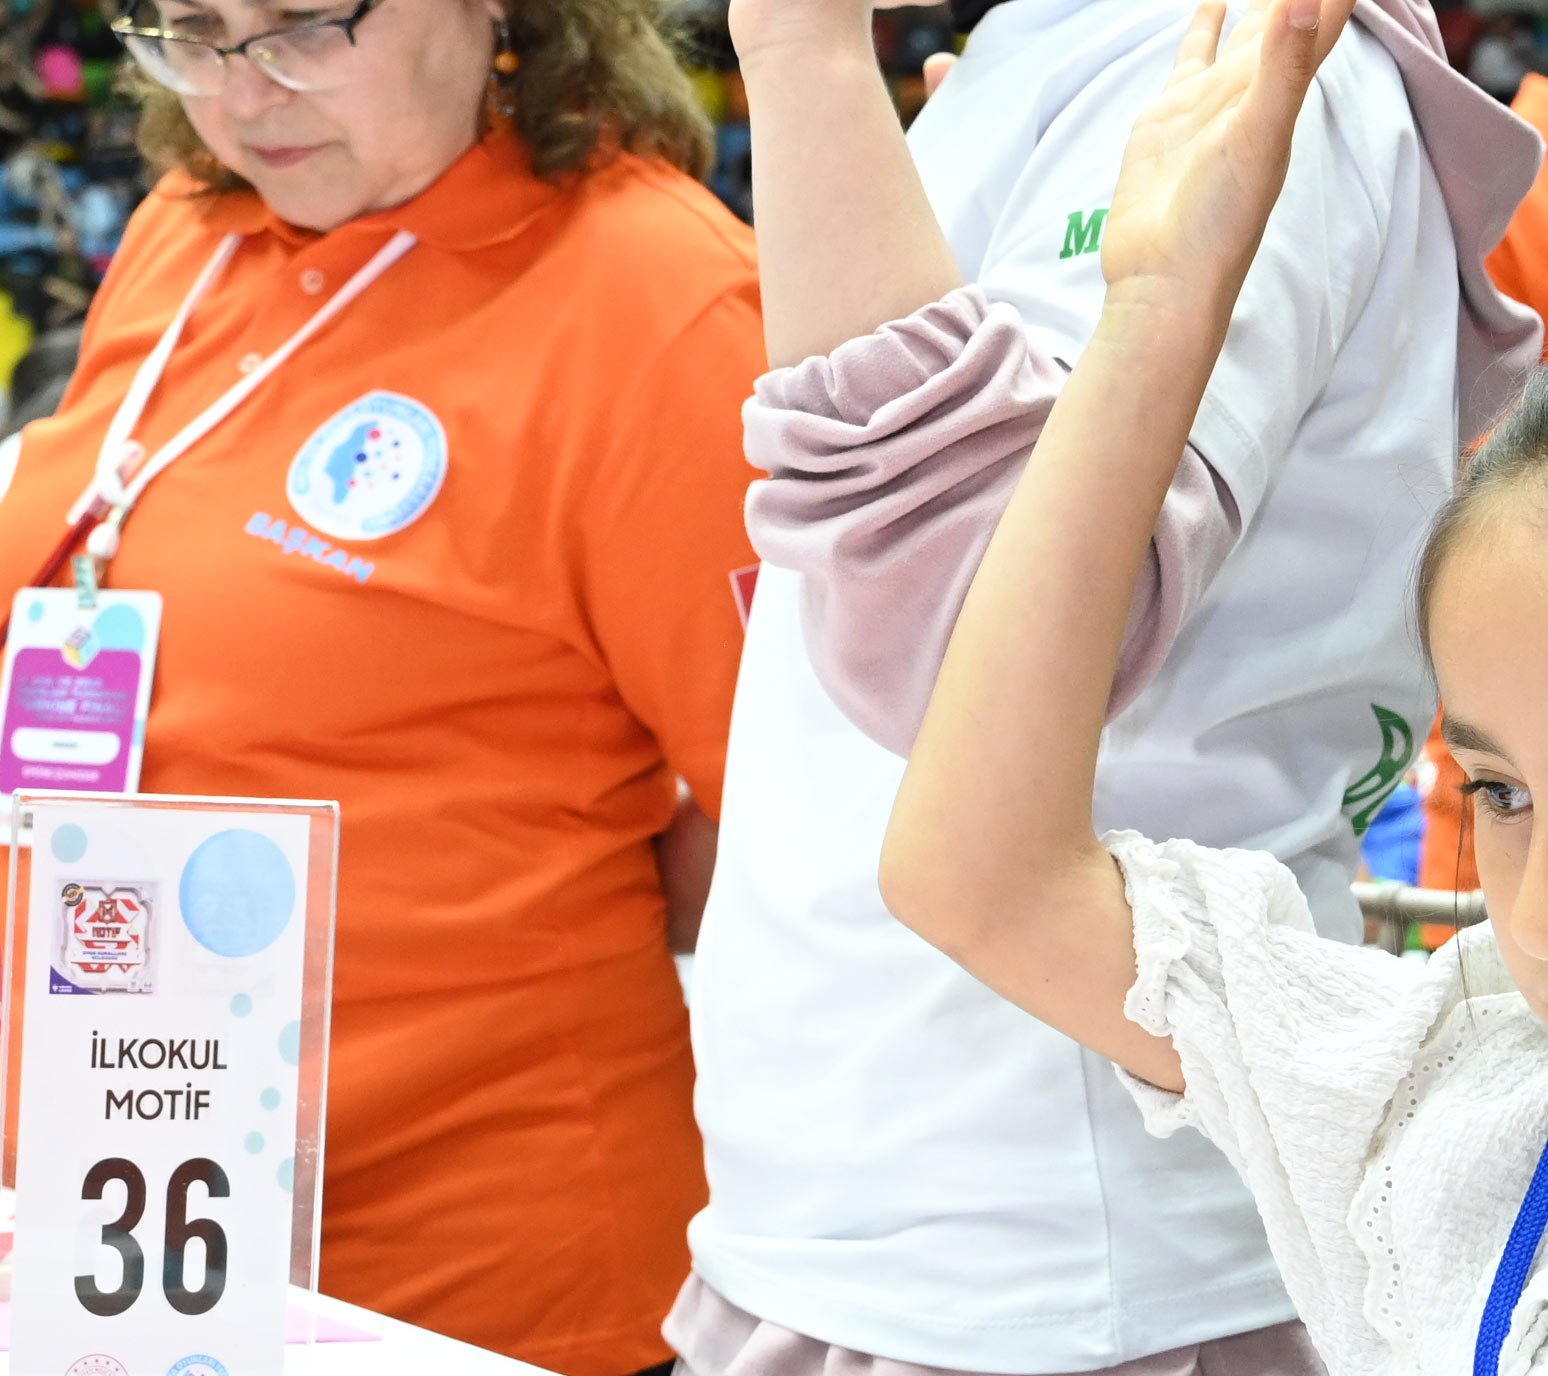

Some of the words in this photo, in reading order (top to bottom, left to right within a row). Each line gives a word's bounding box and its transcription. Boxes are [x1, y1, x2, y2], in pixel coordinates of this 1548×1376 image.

[91, 1030, 228, 1070] İLKOKUL
[105, 1082, 211, 1121] MOTİF
[74, 1157, 231, 1317] 36
